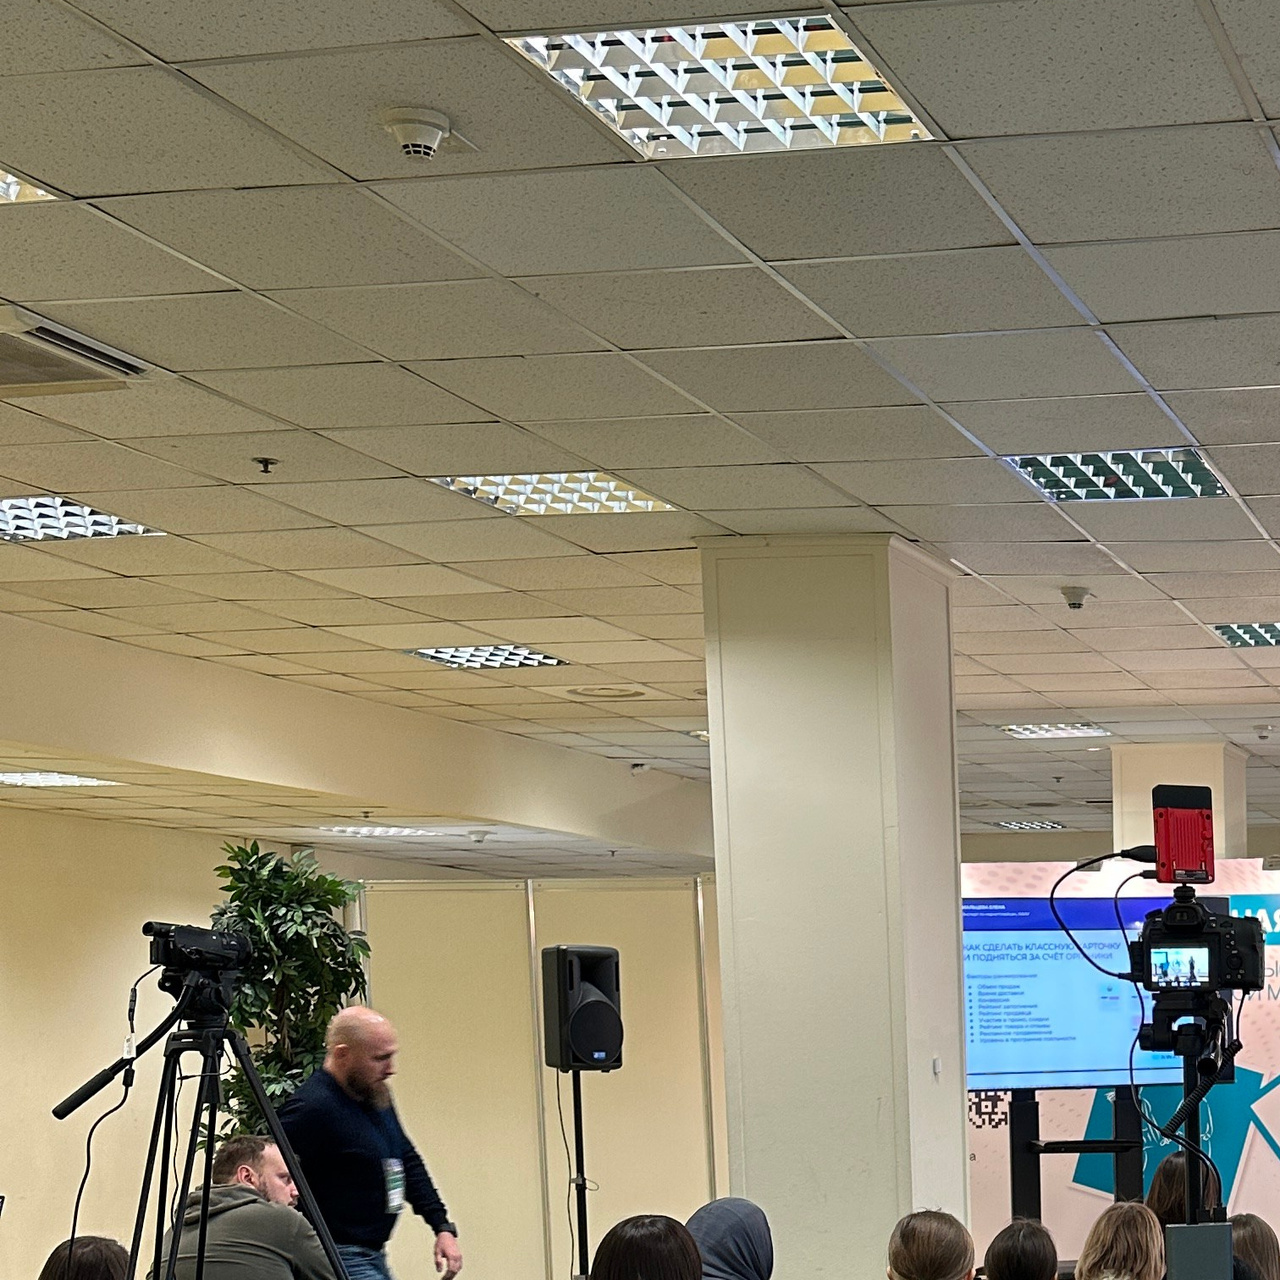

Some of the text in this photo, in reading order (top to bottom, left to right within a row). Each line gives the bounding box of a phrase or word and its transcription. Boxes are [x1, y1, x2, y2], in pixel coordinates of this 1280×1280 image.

[982, 943, 1023, 952] СДЕЛАТЬ
[973, 952, 1027, 962] ПОДНЯТЬСЯ
[1029, 952, 1040, 961] ЗА
